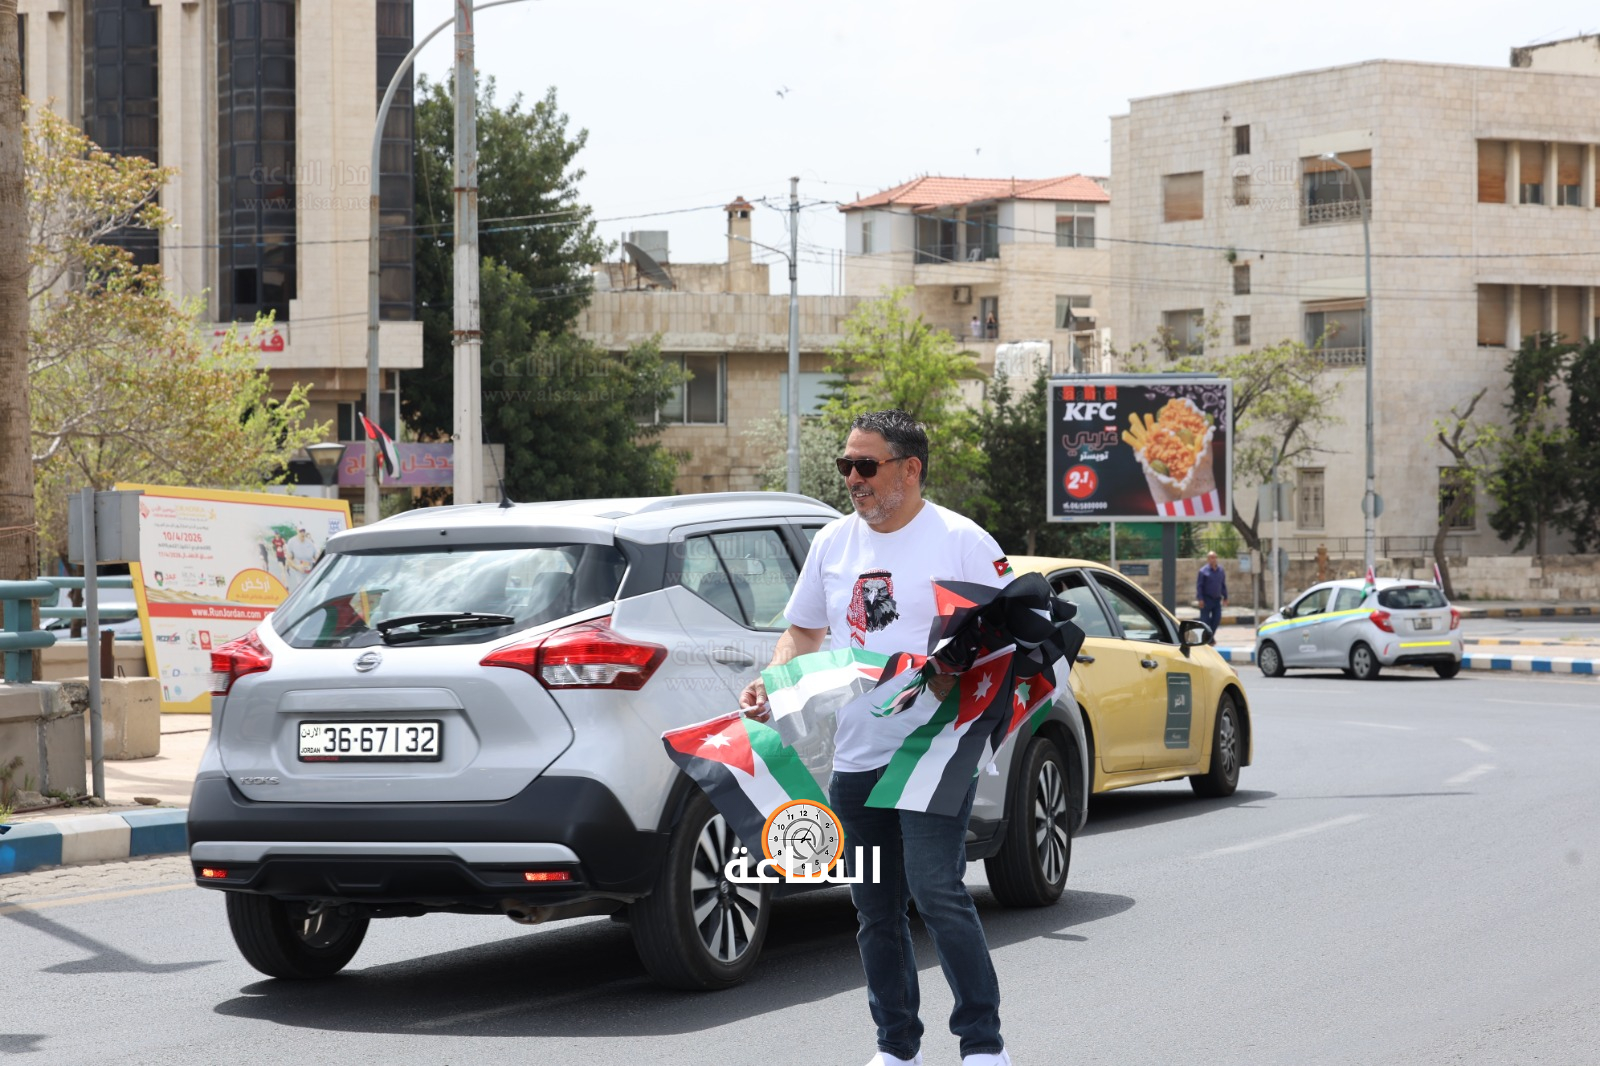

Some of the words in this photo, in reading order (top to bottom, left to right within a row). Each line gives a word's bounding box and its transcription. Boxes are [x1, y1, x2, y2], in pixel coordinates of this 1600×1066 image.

[1063, 402, 1116, 421] KFC
[1062, 430, 1118, 456] عربي
[1080, 451, 1109, 462] تويستر
[162, 531, 202, 543] 10/4/2026
[241, 576, 270, 592] أركض
[191, 607, 261, 619] www.RunJordan.com
